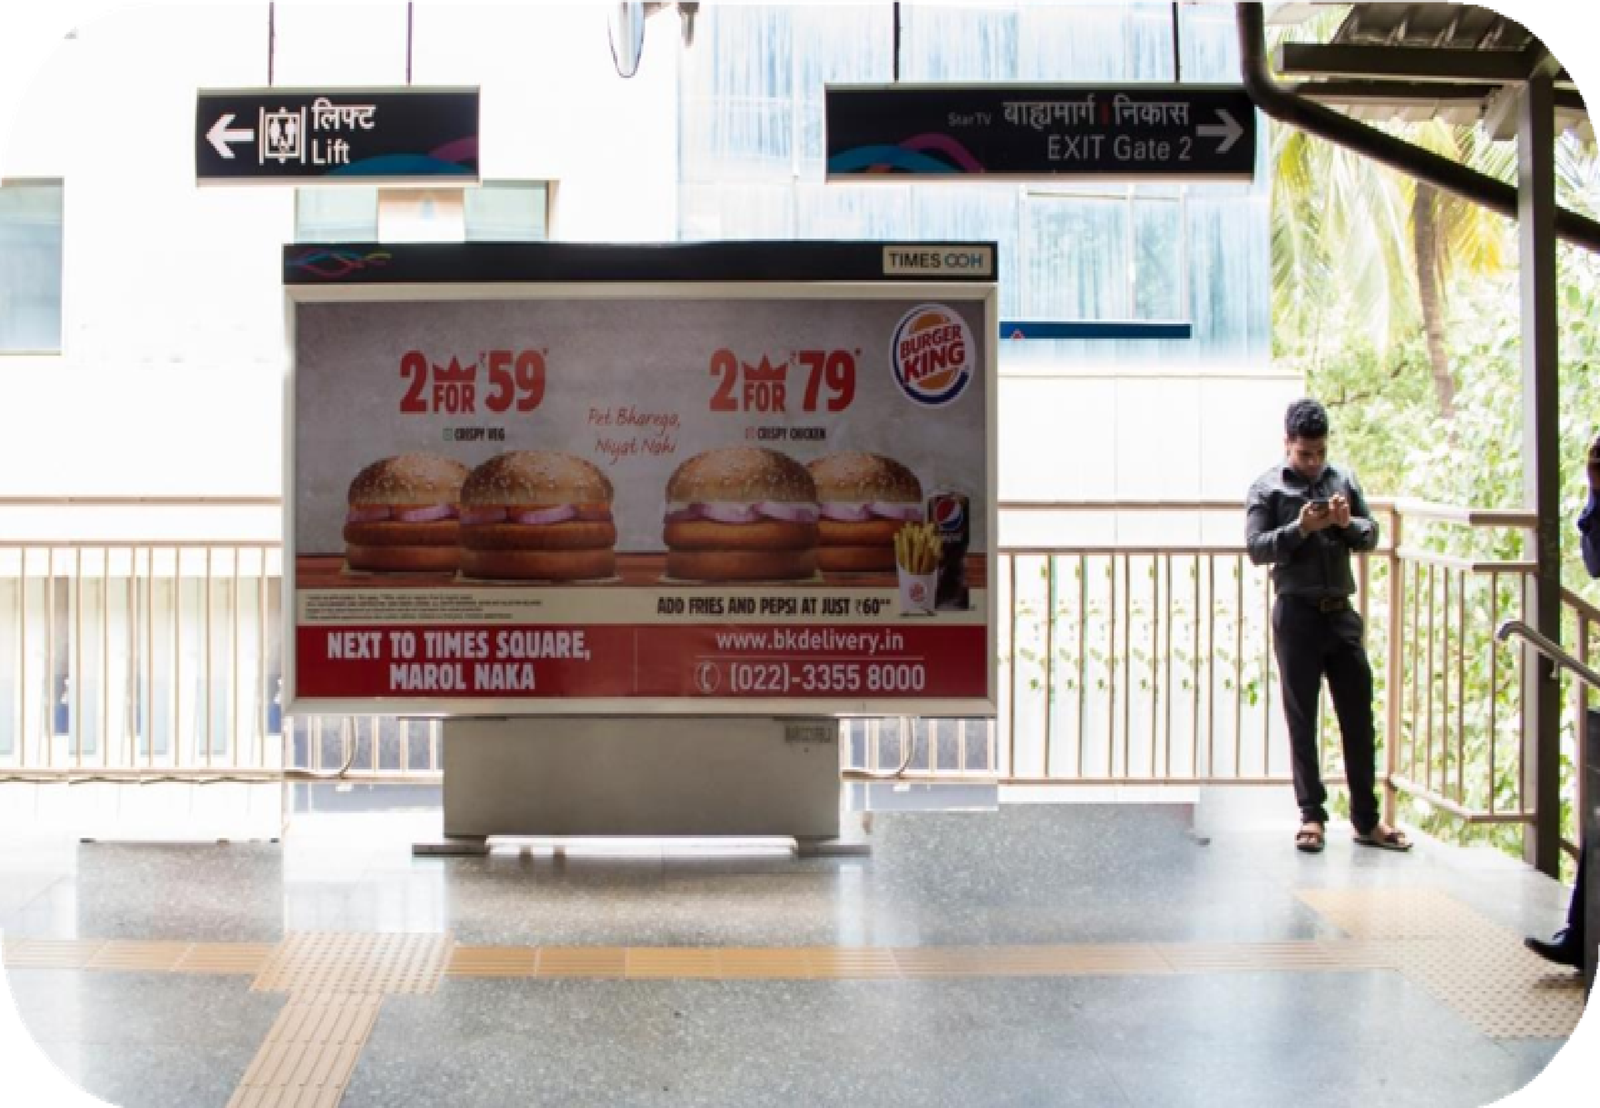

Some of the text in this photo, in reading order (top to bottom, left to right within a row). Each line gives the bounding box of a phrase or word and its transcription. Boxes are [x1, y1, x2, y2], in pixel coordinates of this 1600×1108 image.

[311, 97, 376, 130] लिफ्ट
[1113, 93, 1190, 125] निकास
[312, 139, 350, 164] Lift
[1048, 134, 1193, 160] EXIT Gate 2
[888, 253, 941, 268] TIMES
[900, 323, 963, 361] BURGER
[904, 341, 966, 384] KING
[400, 350, 428, 413] 2
[433, 384, 475, 414] FOR
[709, 348, 738, 412] 2
[743, 383, 786, 413] FOR
[454, 428, 505, 441] CRISPY VEG
[757, 428, 826, 441] CRISPY CHICKEN
[657, 597, 684, 615] ADD
[688, 597, 724, 615] FRIES
[728, 597, 756, 615] AND
[759, 597, 797, 615] PEPSI
[801, 597, 818, 615] AT
[821, 597, 850, 615] JUST
[327, 631, 591, 661] NEXT TO TIMES SQUARE,
[715, 628, 904, 655] www.bkdelivery.in
[389, 663, 535, 690] MAROL NAKA
[730, 662, 925, 692] (022)-3355 8000
